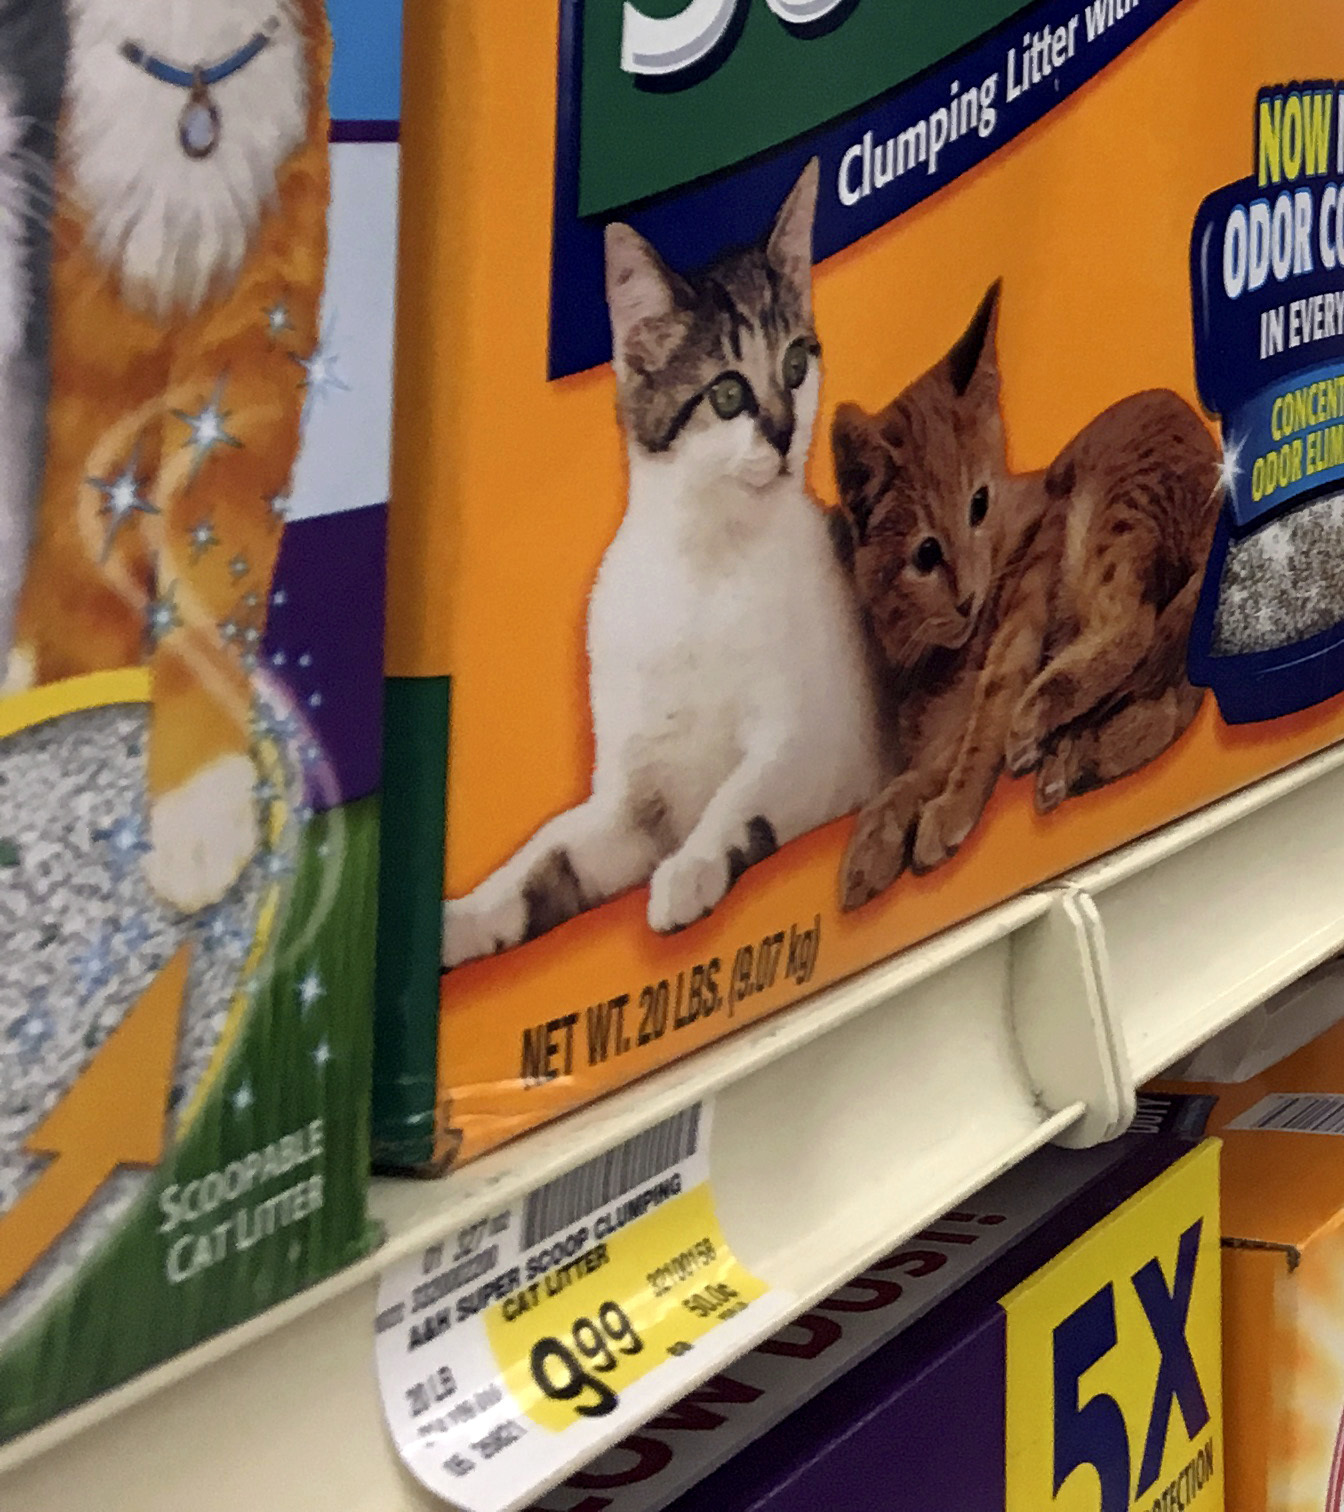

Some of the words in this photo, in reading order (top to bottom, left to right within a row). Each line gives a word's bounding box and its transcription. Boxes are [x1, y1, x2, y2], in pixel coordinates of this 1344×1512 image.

[837, 71, 1000, 207] Clumping
[1005, 12, 1080, 104] Litter
[1257, 91, 1333, 188] NOW
[1222, 188, 1313, 300] ODOR
[1259, 305, 1285, 360] IN
[1250, 438, 1303, 503] ODOR
[519, 1013, 578, 1090] NET
[585, 992, 634, 1069] WT.
[636, 980, 673, 1049] 20
[672, 957, 723, 1030] LBS.
[158, 1117, 325, 1235] SCOOPABLE
[166, 1224, 233, 1284] CAT
[235, 1174, 325, 1251] LITTER
[454, 1264, 523, 1324] SUPER
[525, 1226, 591, 1285] SCOOP
[501, 1282, 544, 1323] CAT
[545, 1244, 611, 1301] LITTER
[1050, 1214, 1213, 1512] 5X
